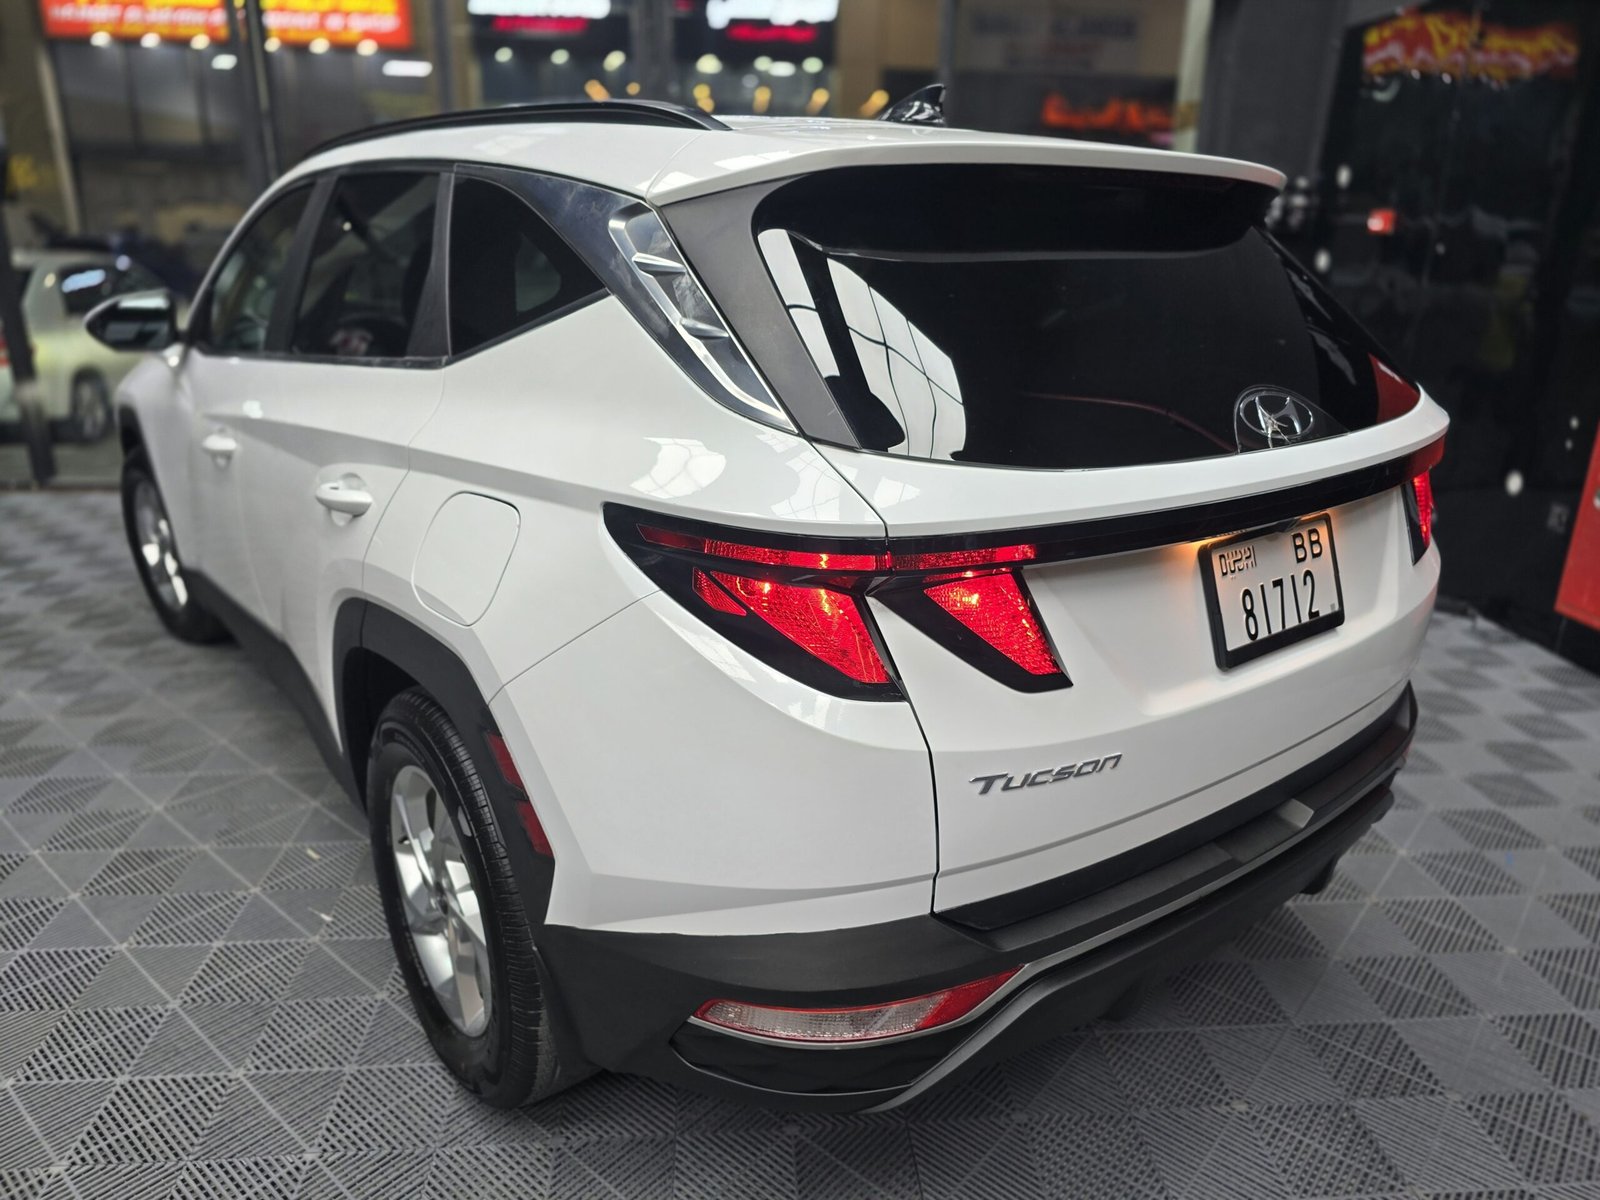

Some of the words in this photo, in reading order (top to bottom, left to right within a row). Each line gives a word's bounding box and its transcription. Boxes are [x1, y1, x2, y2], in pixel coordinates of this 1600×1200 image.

[1292, 528, 1323, 563] BB
[1241, 569, 1320, 641] 81712
[969, 753, 1122, 795] TUCSON
